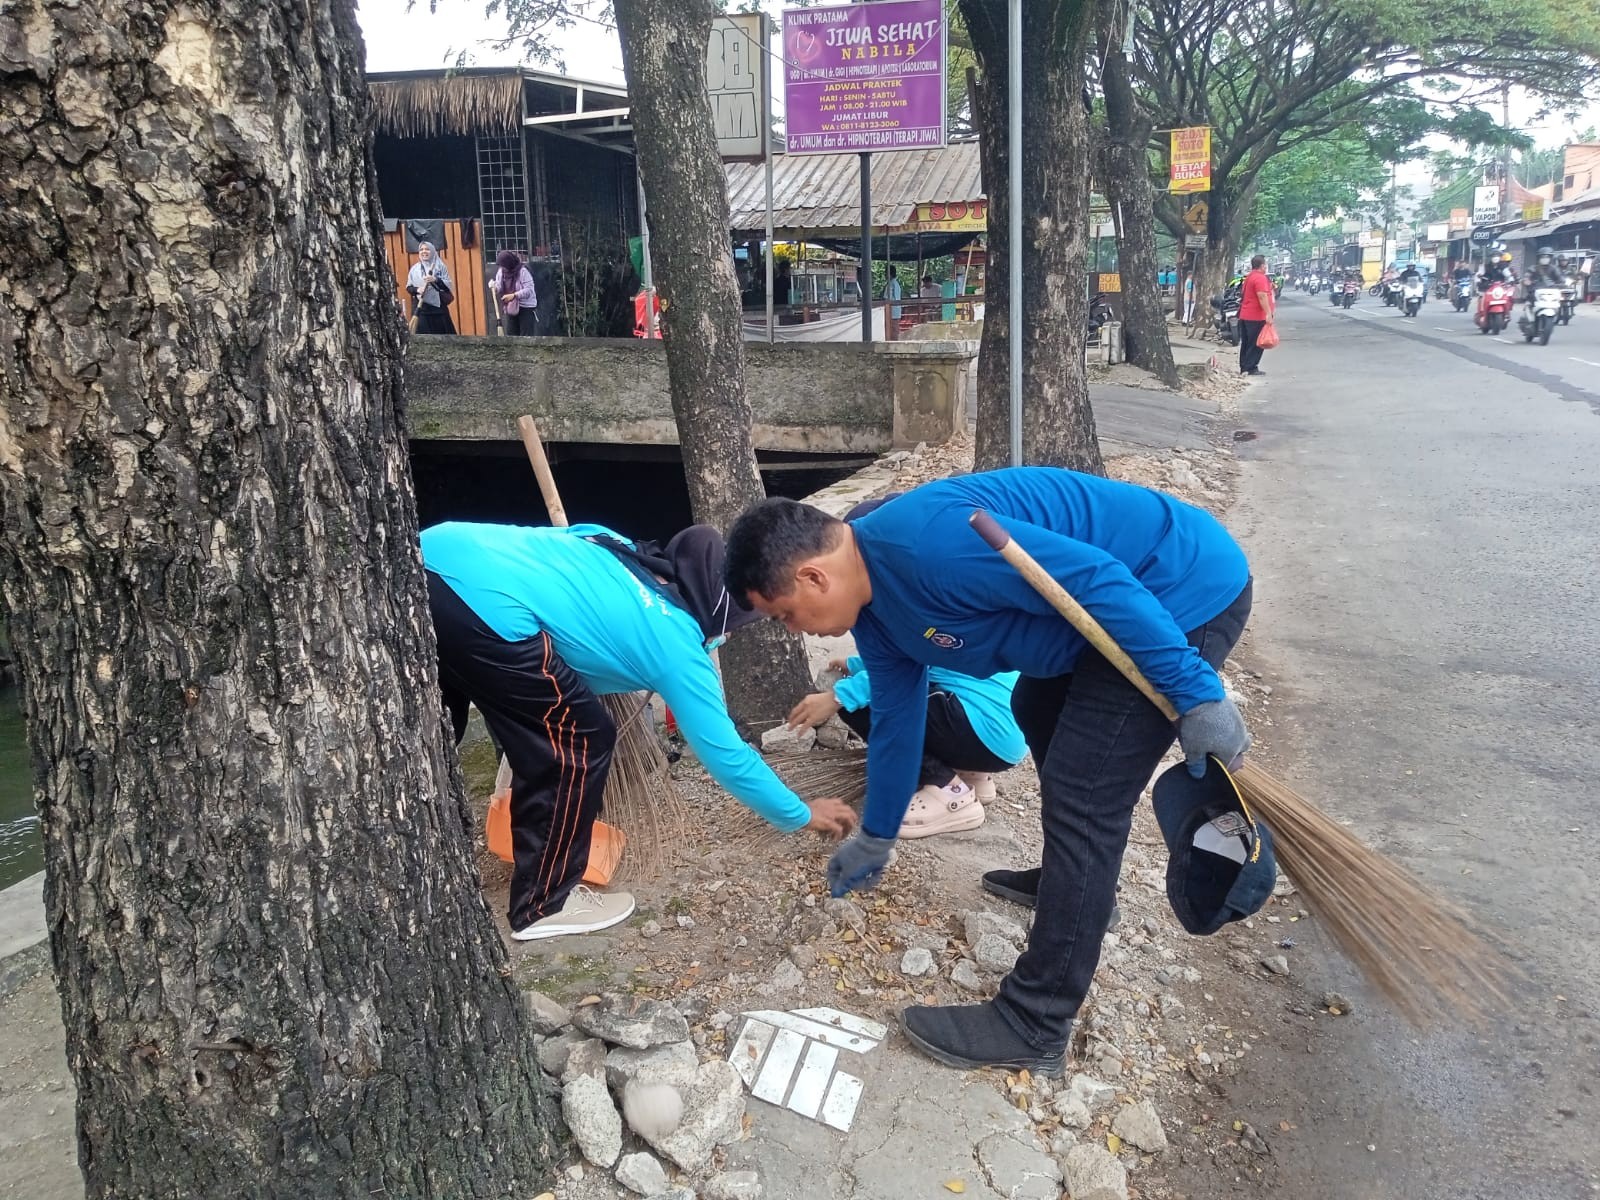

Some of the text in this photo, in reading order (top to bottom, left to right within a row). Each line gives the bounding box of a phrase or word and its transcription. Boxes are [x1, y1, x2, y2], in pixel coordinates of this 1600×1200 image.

[788, 11, 849, 26] KLINIK PRATAMA
[825, 19, 938, 47] JIWA SEHAT
[841, 43, 917, 61] NABILA
[848, 64, 878, 76] HIPNOTERAPI
[901, 60, 938, 73] LABORATORIUM
[824, 79, 903, 92] JADWAL PRAKTEK
[819, 95, 838, 103] HARI
[843, 93, 867, 102] SENIN
[871, 91, 896, 100] SABTU
[819, 104, 836, 112] JAM
[843, 102, 865, 110] 08.00
[869, 101, 891, 109] 21.00
[892, 99, 908, 107] WIB
[831, 111, 889, 122] JUMAT LIBUR
[821, 124, 836, 132] WA
[789, 127, 940, 149] dr. UMUM dan dr. HIPNOTERAPI (TERAPI JIWA)
[1175, 161, 1207, 172] TETAP
[1174, 170, 1204, 179] BUKA
[929, 199, 988, 220] SOT
[1474, 213, 1496, 222] VAPOR
